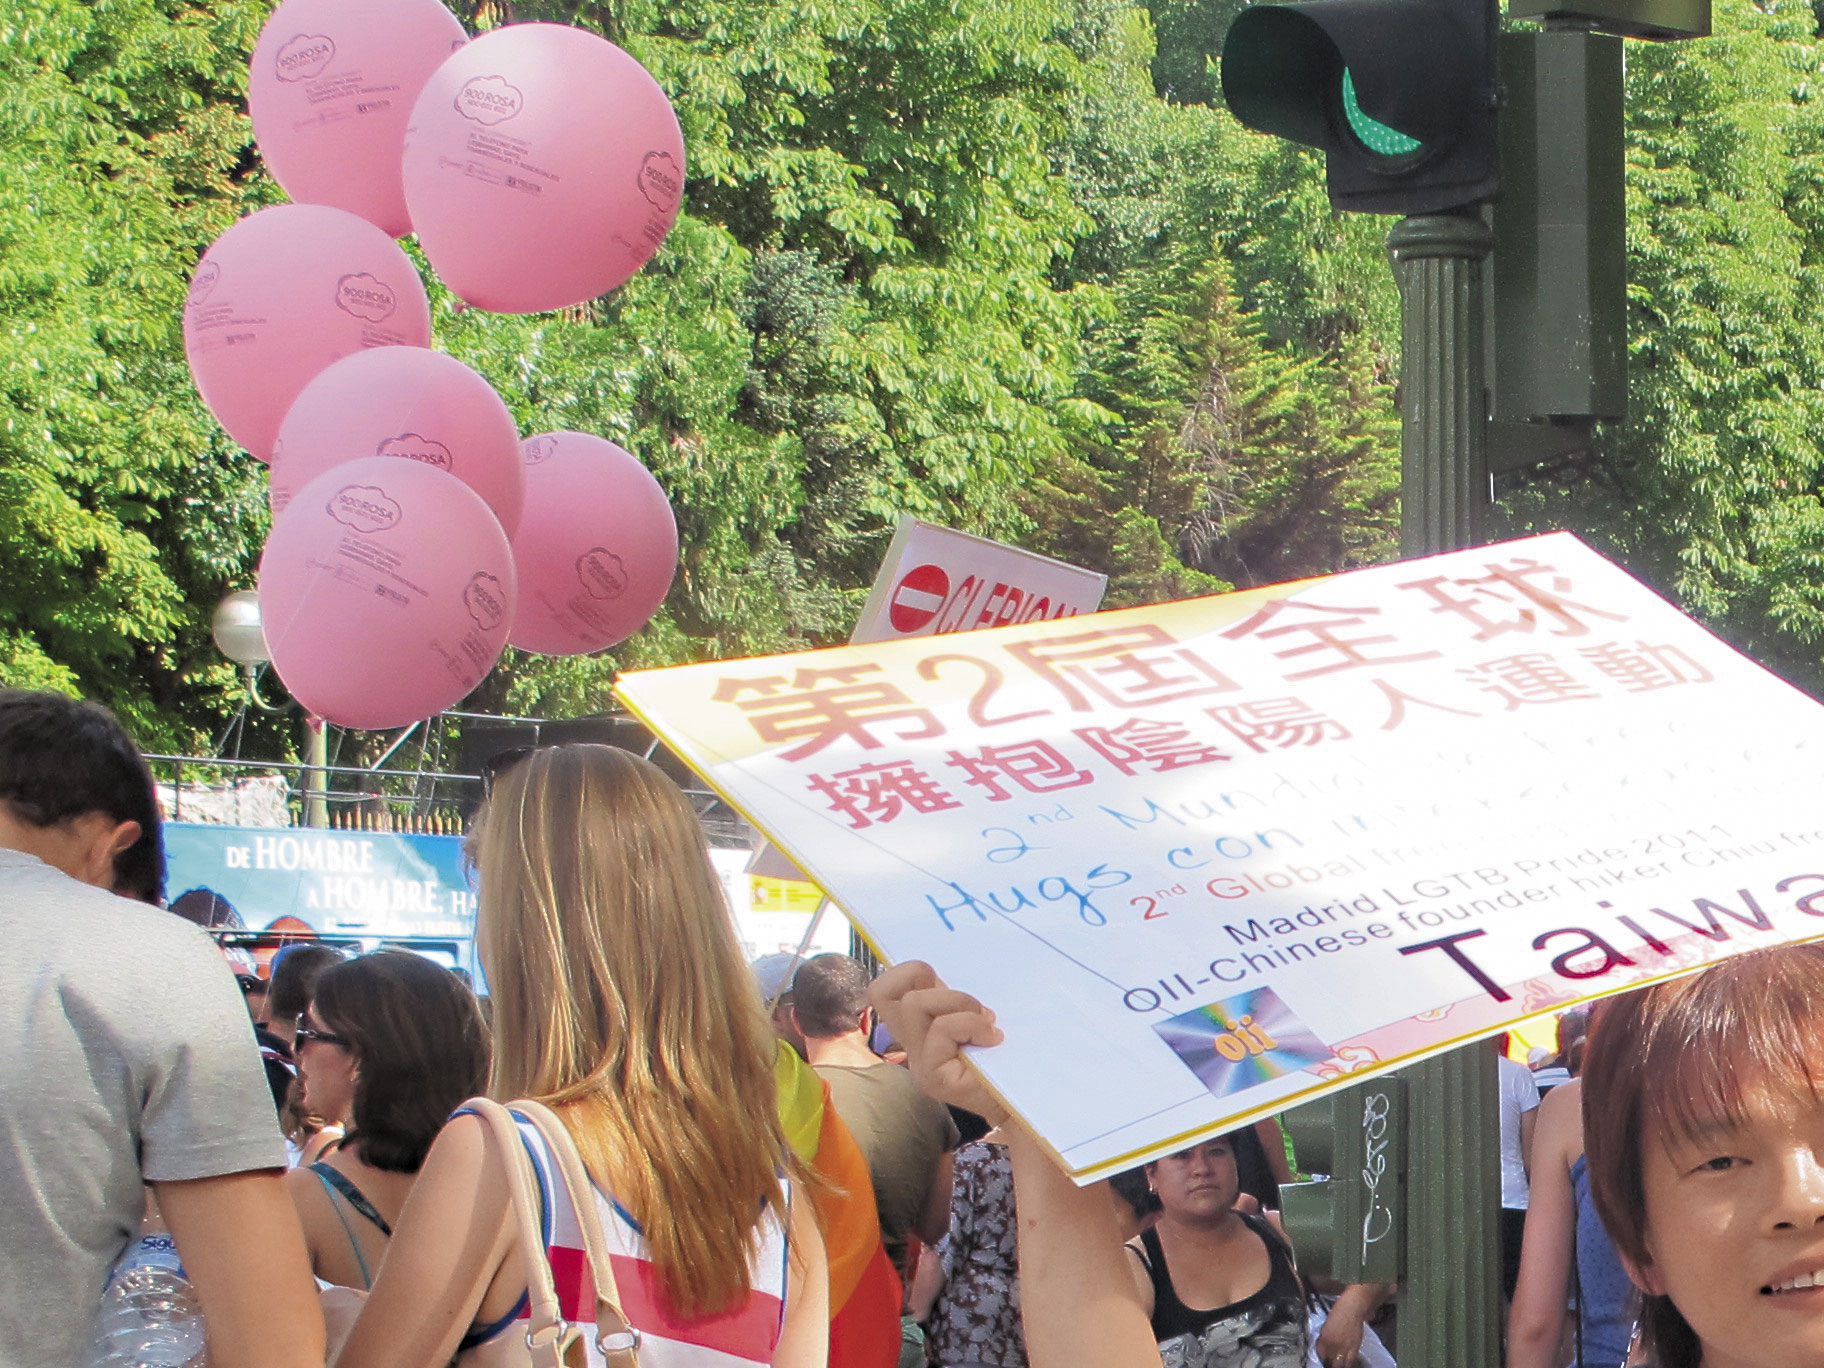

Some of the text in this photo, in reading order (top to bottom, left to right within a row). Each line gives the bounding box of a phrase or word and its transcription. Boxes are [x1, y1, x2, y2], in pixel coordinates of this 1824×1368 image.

[485, 92, 516, 110] ROSA
[711, 558, 1631, 763] 第2屆全球
[226, 836, 374, 872] DE HOMBRE
[924, 828, 1304, 932] Hugs con
[1129, 882, 1188, 921] 2nd
[1205, 854, 1367, 900] Global
[1222, 823, 1735, 946] Madrid LGTB Pride 2011
[1398, 880, 1561, 932] founder
[1573, 860, 1674, 893] hiker
[1681, 839, 1778, 868] Chiu
[307, 886, 320, 908] A
